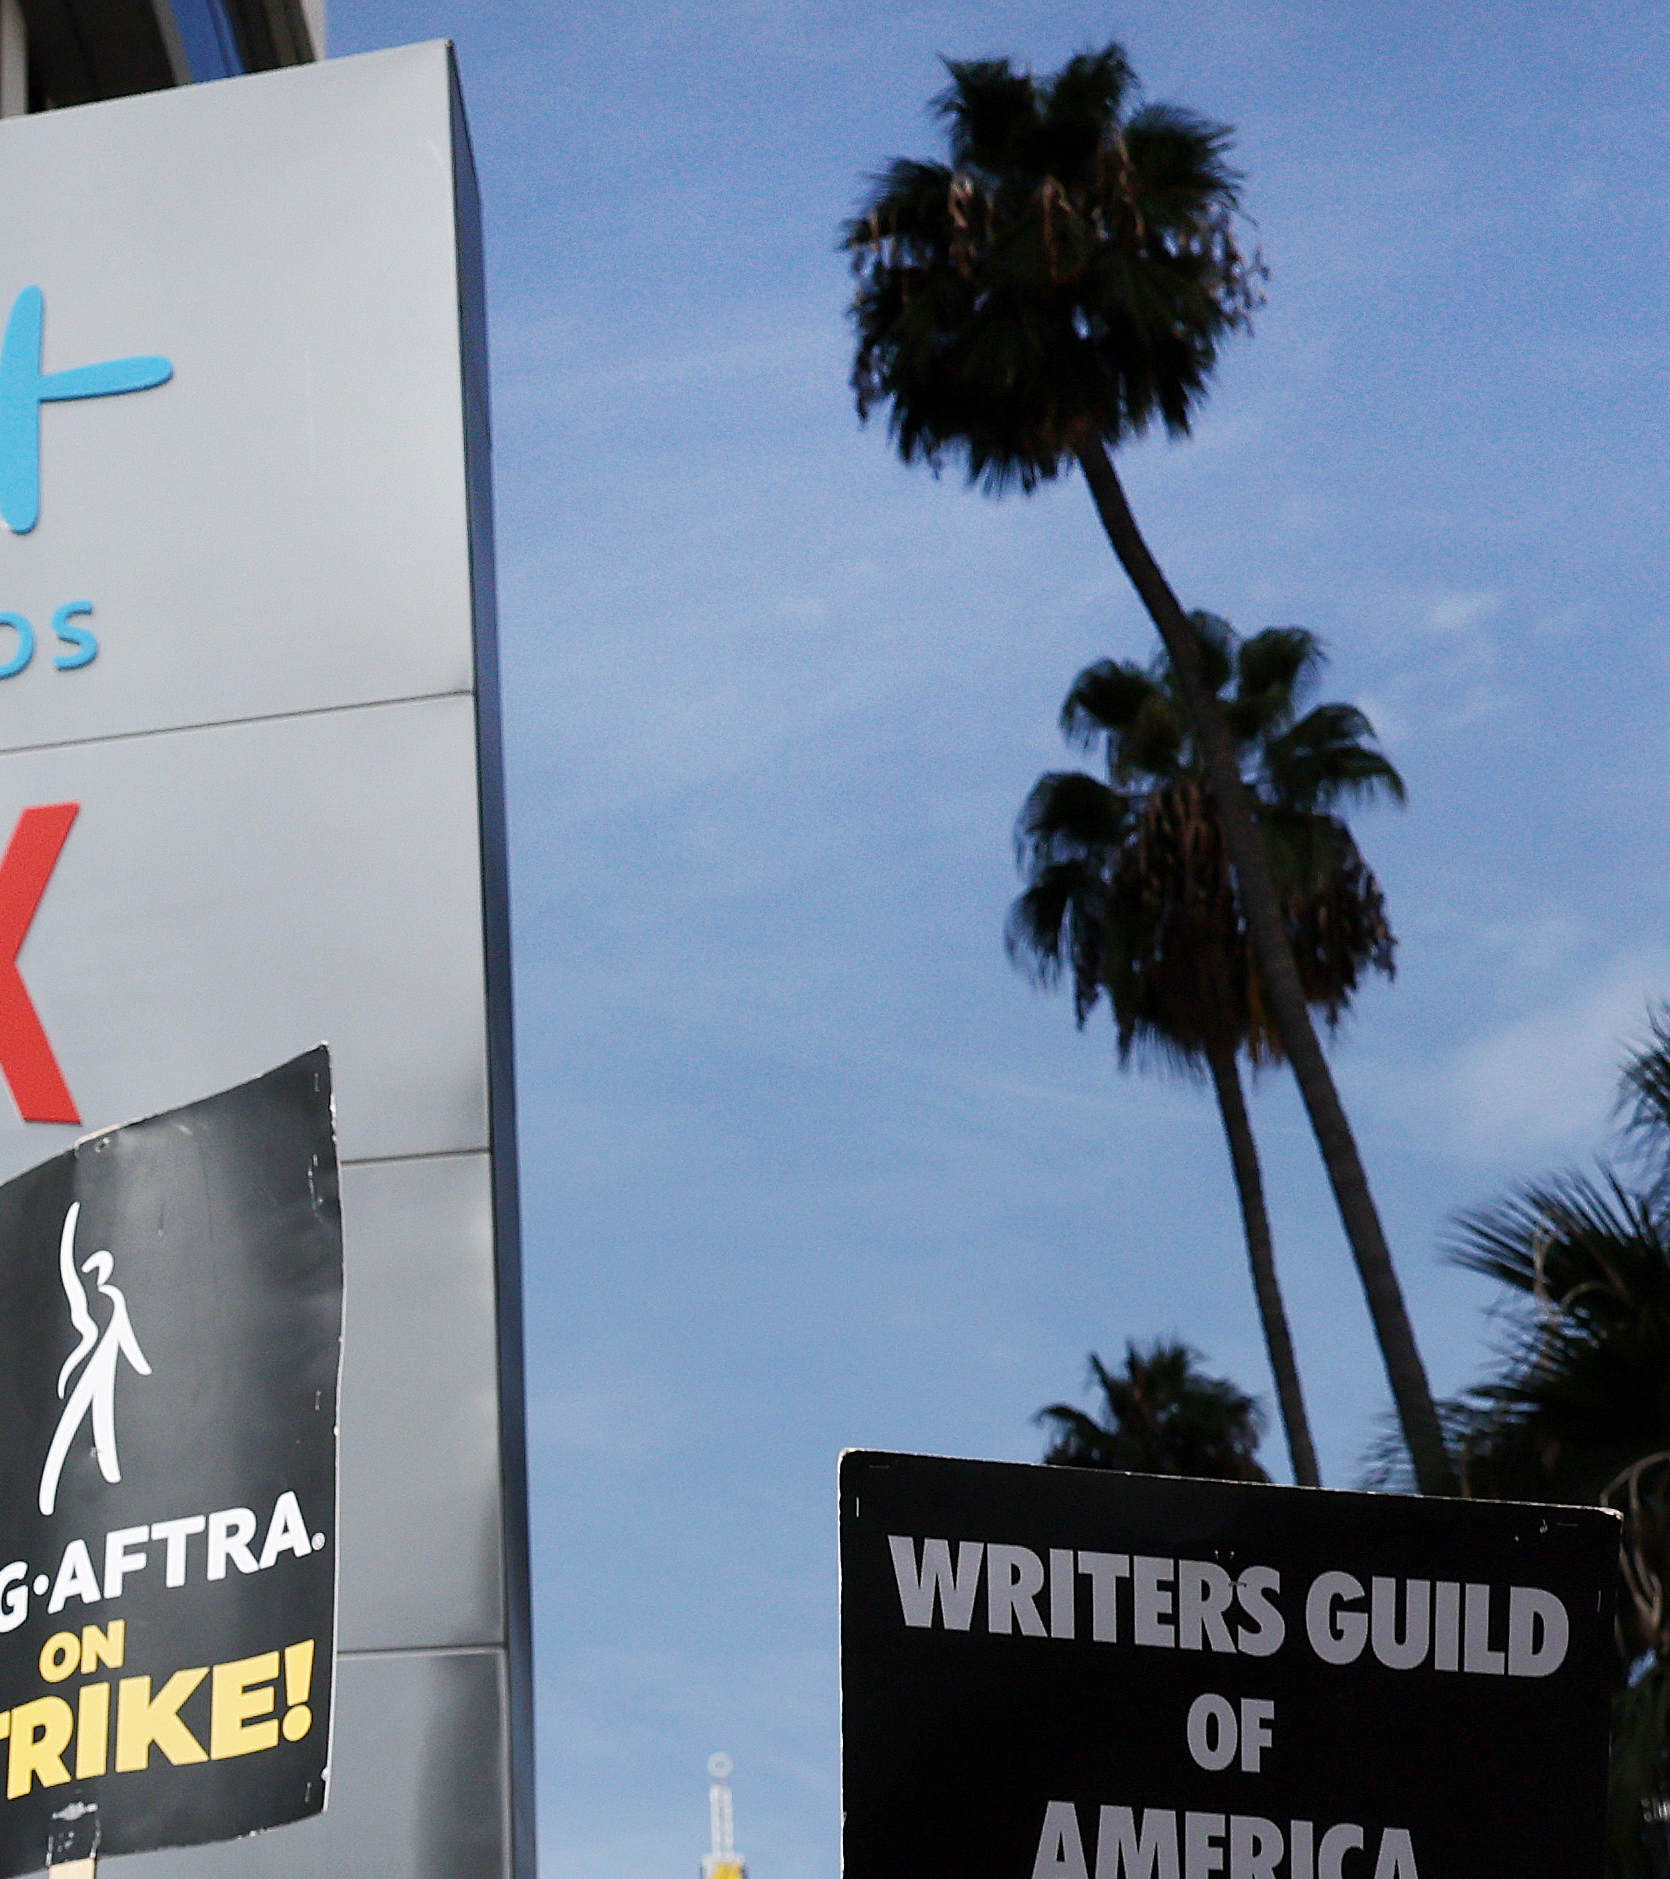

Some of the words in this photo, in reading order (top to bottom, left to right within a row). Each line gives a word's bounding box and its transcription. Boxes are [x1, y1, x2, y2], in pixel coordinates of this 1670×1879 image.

[887, 1533, 1286, 1657] WRITERS
[1304, 1570, 1570, 1679] GUILD
[38, 1618, 126, 1684] ON
[1186, 1692, 1275, 1773] OF
